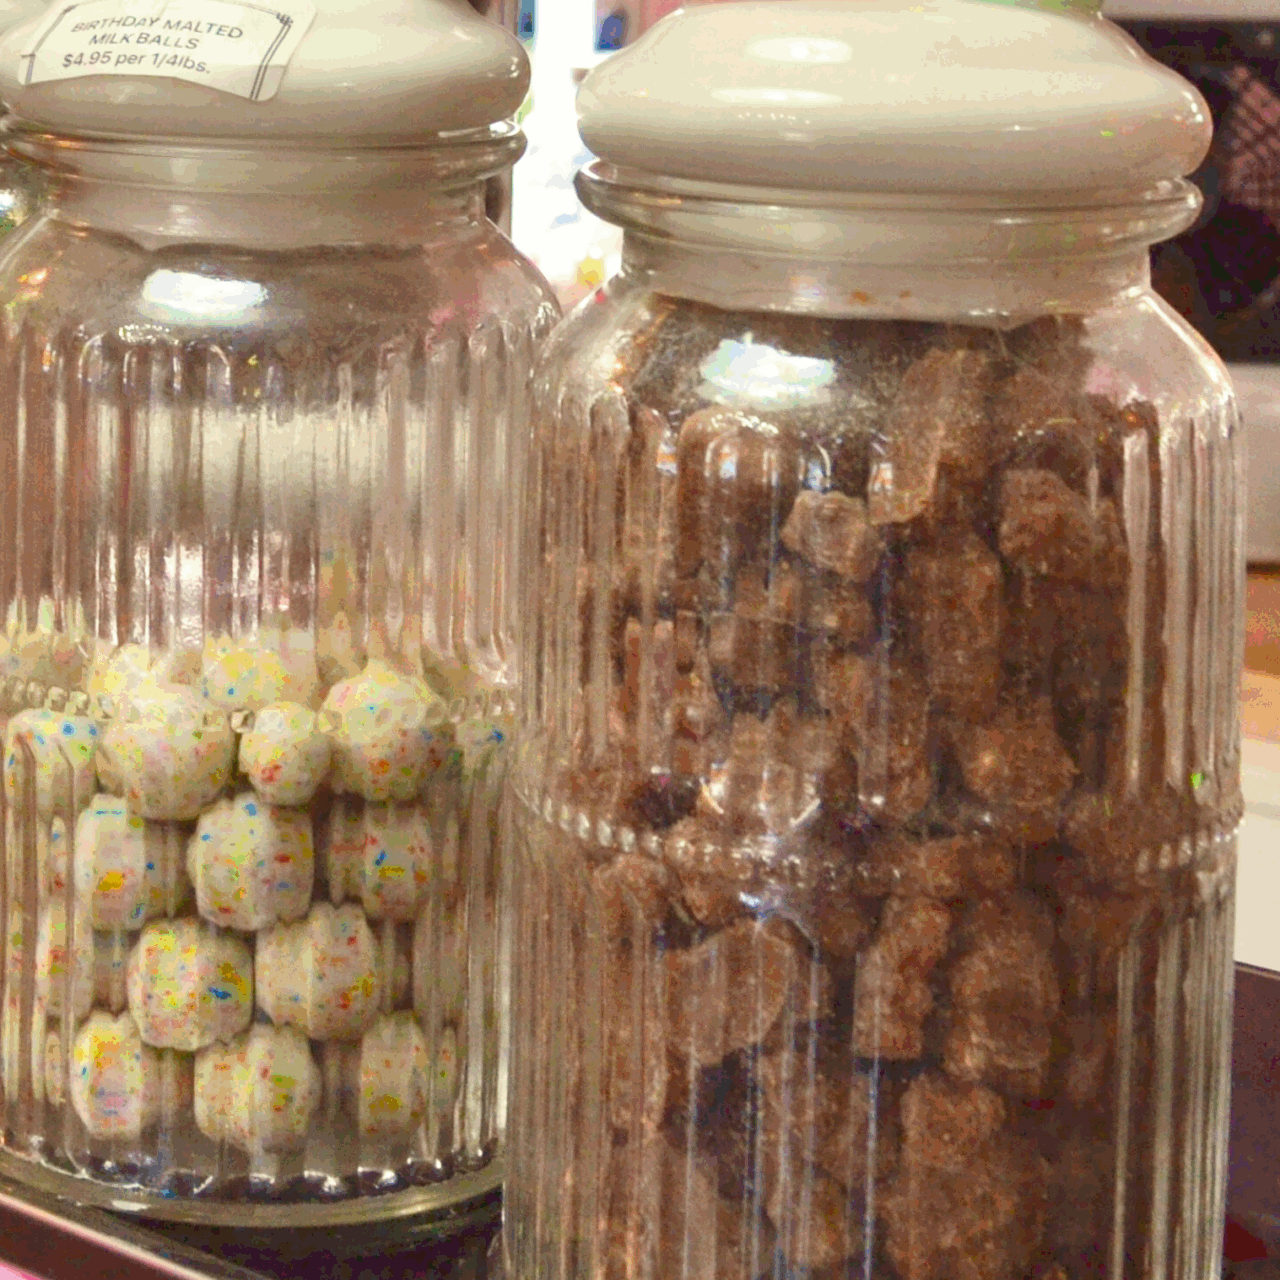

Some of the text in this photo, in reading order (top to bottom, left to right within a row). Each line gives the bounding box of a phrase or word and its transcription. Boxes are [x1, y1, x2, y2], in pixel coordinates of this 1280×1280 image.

[70, 15, 244, 39] BIRTHDAY MALTED
[88, 31, 200, 50] MILK BALLS
[61, 50, 211, 74] $4.95 per 1/4lbs.
